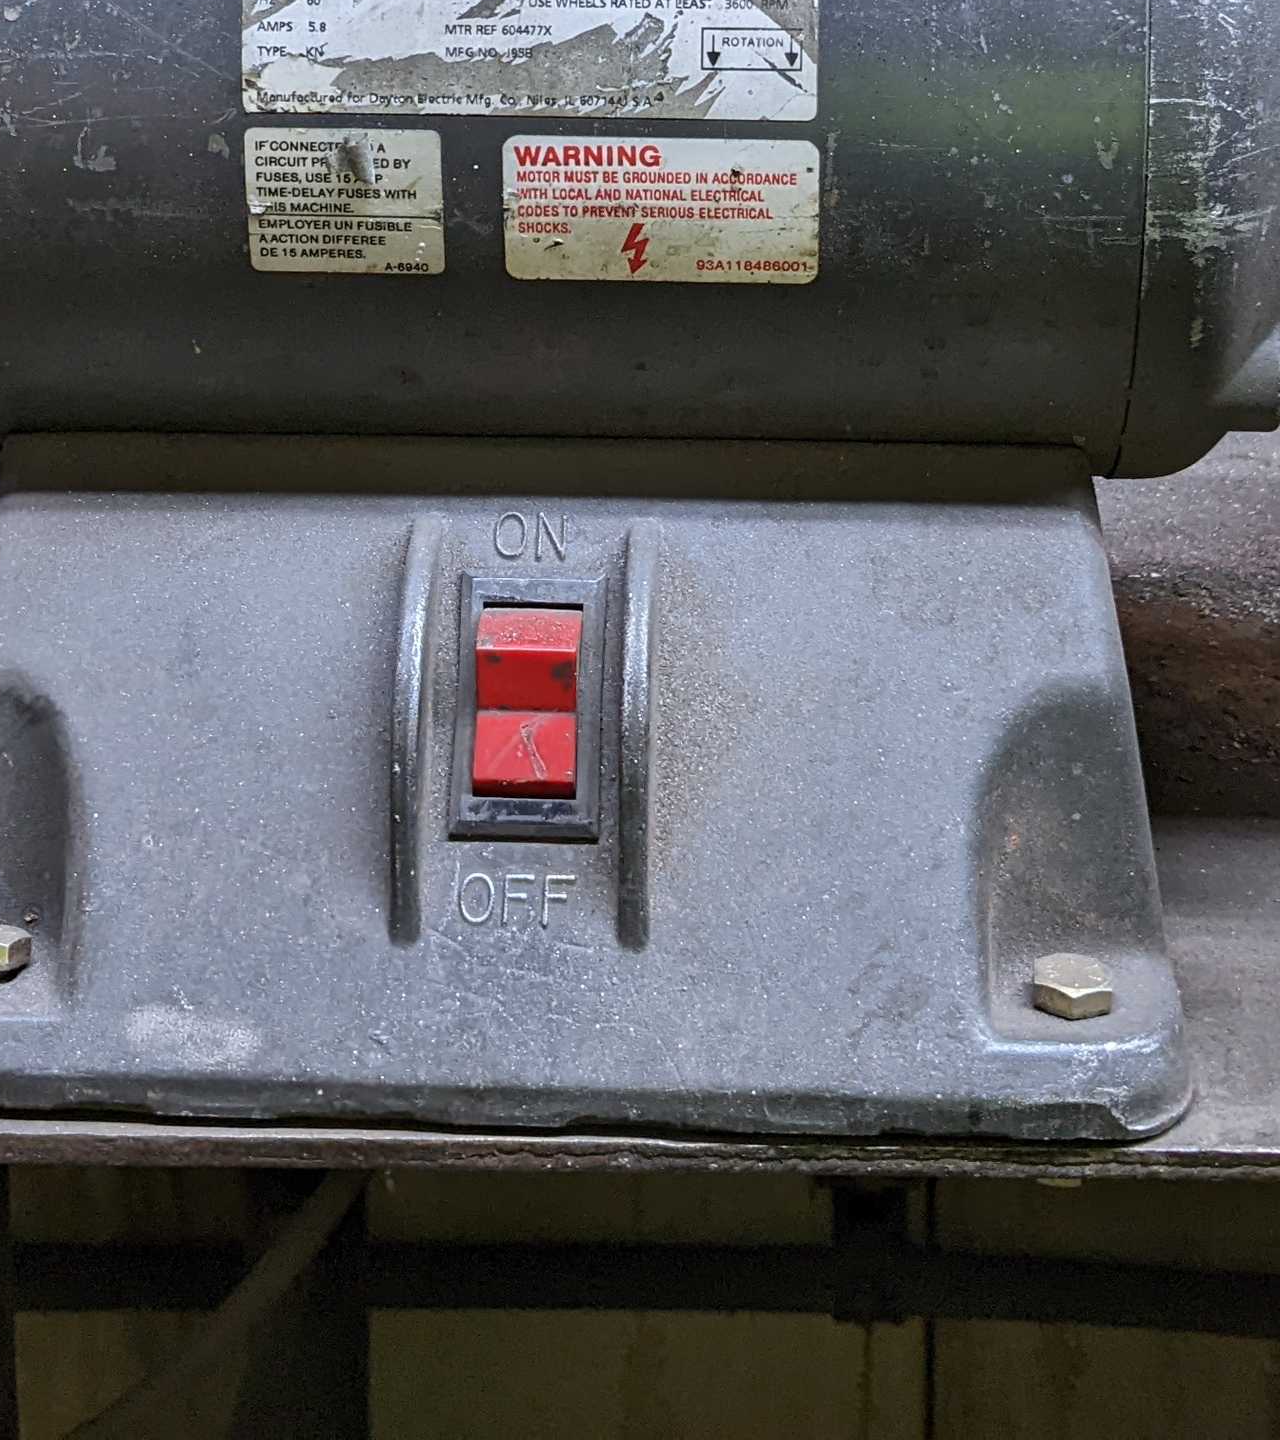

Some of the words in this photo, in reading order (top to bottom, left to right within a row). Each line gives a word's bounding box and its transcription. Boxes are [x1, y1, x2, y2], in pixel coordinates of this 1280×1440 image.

[257, 22, 293, 32] AMPS
[308, 22, 327, 32] 5.8
[445, 25, 472, 35] MTR
[475, 25, 498, 36] REF
[501, 25, 552, 36] 604477X
[722, 37, 784, 48] ROTATION
[257, 46, 288, 57] TYPE
[306, 46, 324, 57] KN
[445, 47, 474, 58] MFG
[257, 91, 343, 105] Manufactured
[347, 91, 365, 103] for
[369, 92, 414, 108] Dayton
[417, 95, 462, 106] Electric
[466, 95, 494, 108] Mfg.
[255, 140, 268, 151] IF
[376, 143, 386, 153] A
[514, 145, 662, 167] WARNING
[255, 157, 307, 167] CIRCUIT
[393, 159, 411, 169] BY
[256, 172, 302, 185] FUSES,
[306, 173, 332, 183] USE
[336, 173, 351, 183] 15
[516, 171, 560, 184] MOTOR
[564, 171, 599, 184] MUST
[603, 171, 619, 184] BE
[623, 172, 692, 185] GROUNDED
[696, 172, 709, 185] IN
[712, 173, 798, 185] ACCORDANCE
[256, 187, 335, 198] TIME-DELAY
[337, 189, 381, 199] FUSES
[384, 190, 417, 200] WITH
[517, 188, 548, 201] WITH
[552, 188, 592, 201] LOCAL
[595, 188, 621, 201] AND
[625, 189, 687, 202] NATIONAL
[691, 190, 765, 202] ELECTRICAL
[517, 205, 559, 218] CODES
[563, 205, 579, 218] TO
[582, 205, 636, 218] PREVENT
[641, 206, 695, 219] SERIOUS
[699, 206, 773, 220] ELECTRICAL
[258, 219, 331, 230] EMPLOYER
[335, 221, 353, 230] UN
[357, 221, 413, 232] FUSIBLE
[518, 221, 572, 234] SHOCKS.
[259, 234, 269, 244] A
[271, 234, 319, 245] ACTION
[322, 235, 387, 246] DIFFEREE
[260, 247, 278, 257] DE
[282, 248, 297, 257] 15
[300, 248, 366, 259] AMPERES.
[494, 510, 570, 560] ON
[458, 872, 577, 928] OFF
